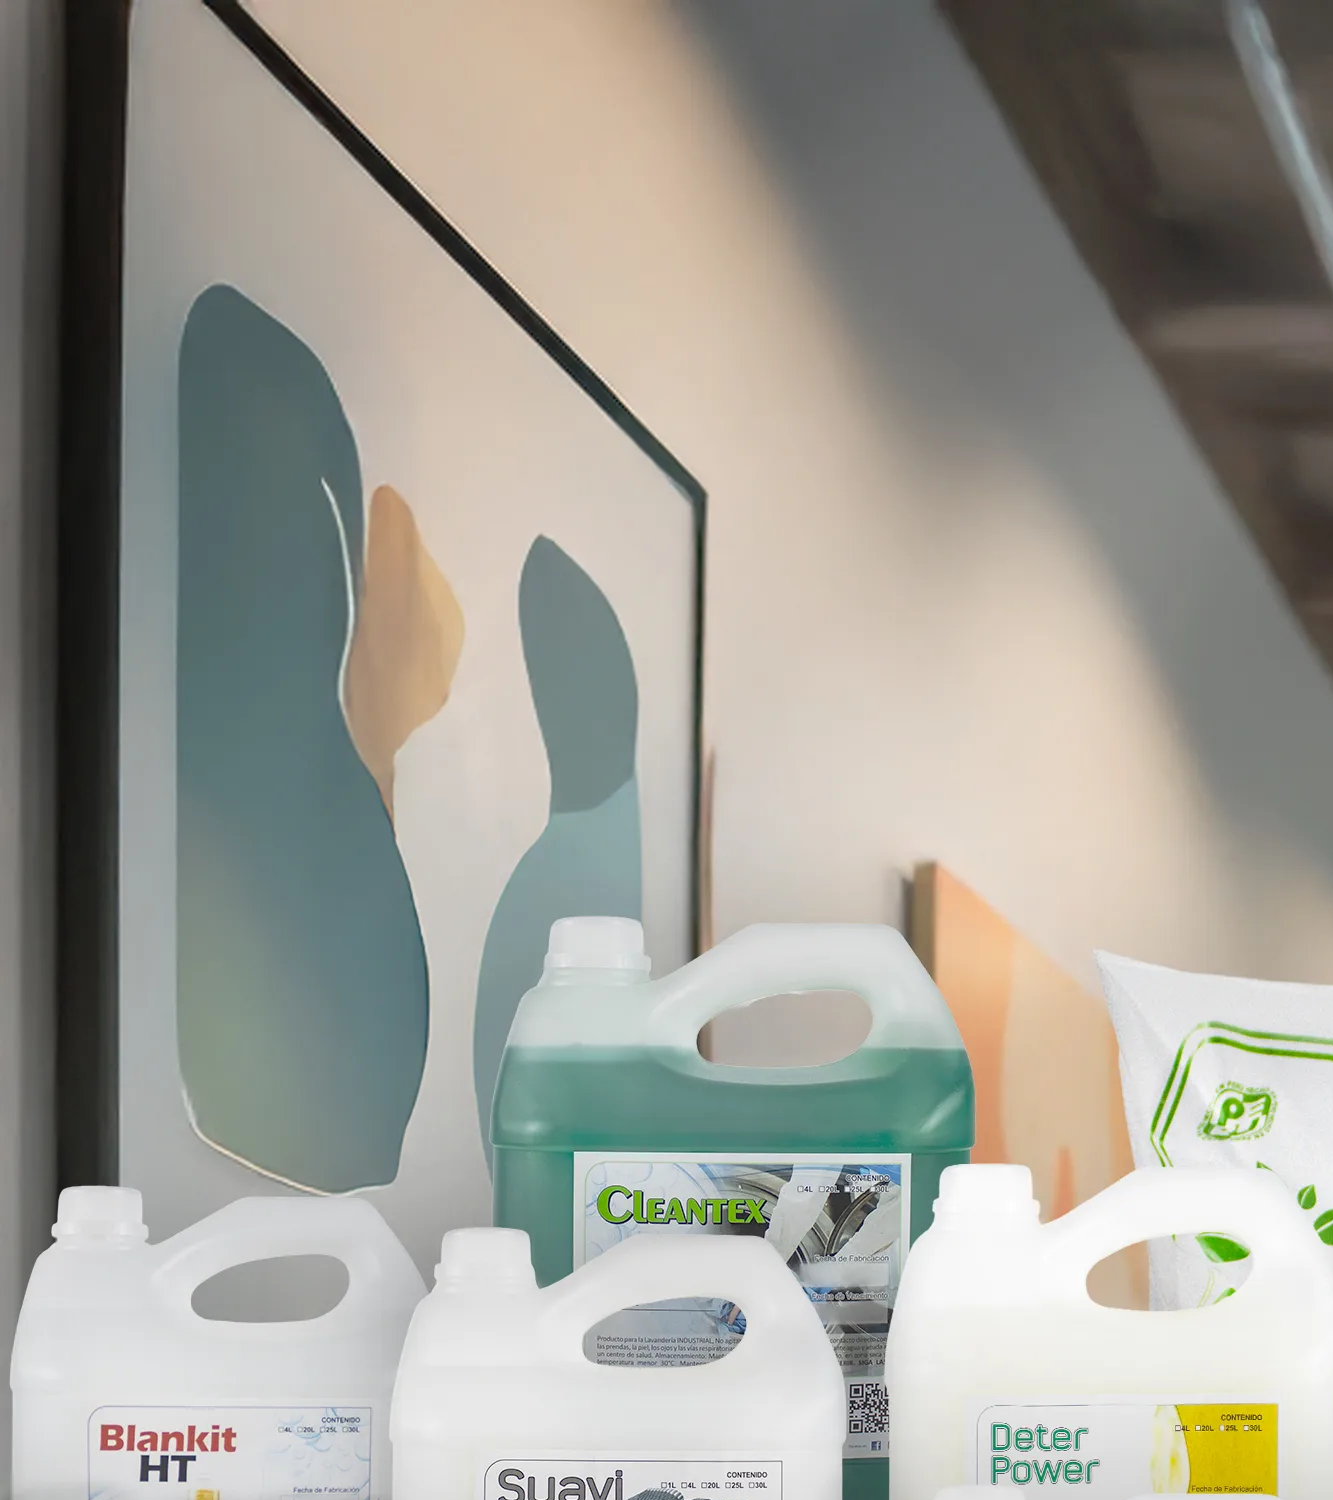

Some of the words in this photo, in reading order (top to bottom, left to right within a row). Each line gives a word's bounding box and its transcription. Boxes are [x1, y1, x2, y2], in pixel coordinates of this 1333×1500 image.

[100, 1424, 236, 1452] Blankit
[990, 1422, 1089, 1452] Deter
[140, 1455, 196, 1482] HT
[990, 1454, 1100, 1485] Power
